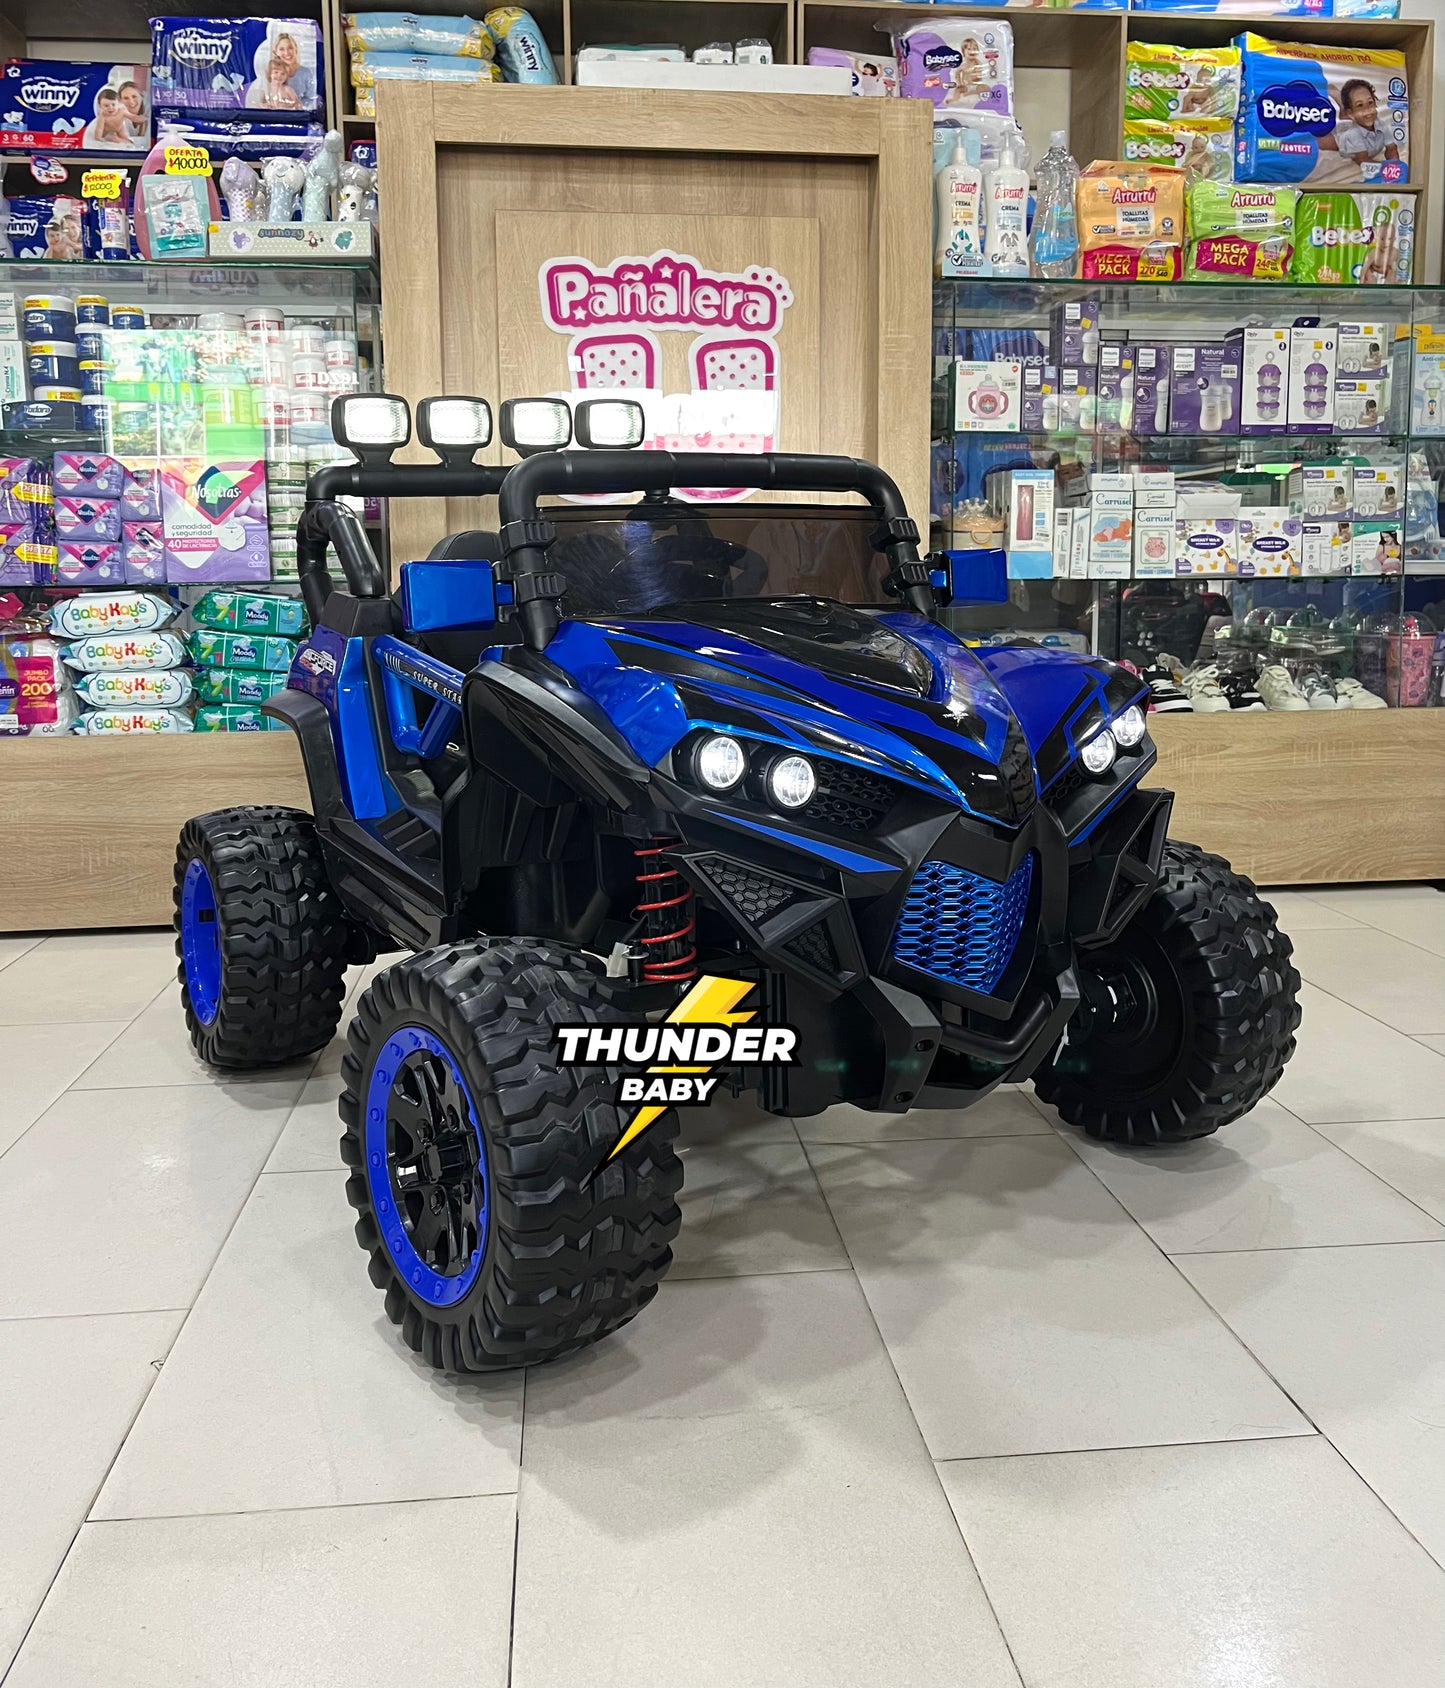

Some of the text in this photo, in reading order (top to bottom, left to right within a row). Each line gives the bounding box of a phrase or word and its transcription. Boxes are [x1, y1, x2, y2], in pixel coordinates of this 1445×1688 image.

[178, 35, 229, 60] winny
[520, 36, 539, 71] winny
[926, 55, 960, 65] Babysec
[1128, 68, 1190, 89] Bebex
[25, 84, 77, 105] winny
[991, 90, 1002, 99] XG
[1262, 99, 1329, 124] Babysec
[23, 134, 34, 142] 60
[169, 149, 203, 158] OFERTA
[1126, 141, 1185, 159] Bebex
[1281, 144, 1311, 153] PROTECT
[1113, 187, 1156, 204] Arrurrú
[1211, 243, 1249, 255] MEGA
[1094, 254, 1131, 264] MEGA
[1213, 253, 1247, 267] PACK
[1098, 264, 1130, 275] PACK
[1140, 266, 1155, 275] 270
[555, 269, 771, 325] Pañalera
[1201, 348, 1225, 356] Natural
[191, 483, 240, 500] Nosotras
[1096, 492, 1132, 505] Carrusel
[1137, 510, 1173, 523] Carrusel
[176, 529, 213, 537] seguridad
[167, 539, 182, 549] 40
[71, 601, 147, 622] Baby Kay's
[245, 610, 269, 621] Moody
[86, 641, 163, 660] Baby Kay's
[232, 647, 256, 658] Moody
[96, 677, 172, 695] Baby Kay's
[412, 670, 439, 691] SUPER
[21, 683, 53, 696] 200
[239, 685, 262, 697] Moody
[95, 715, 170, 732] Baby Kay's
[236, 722, 260, 731] Moody
